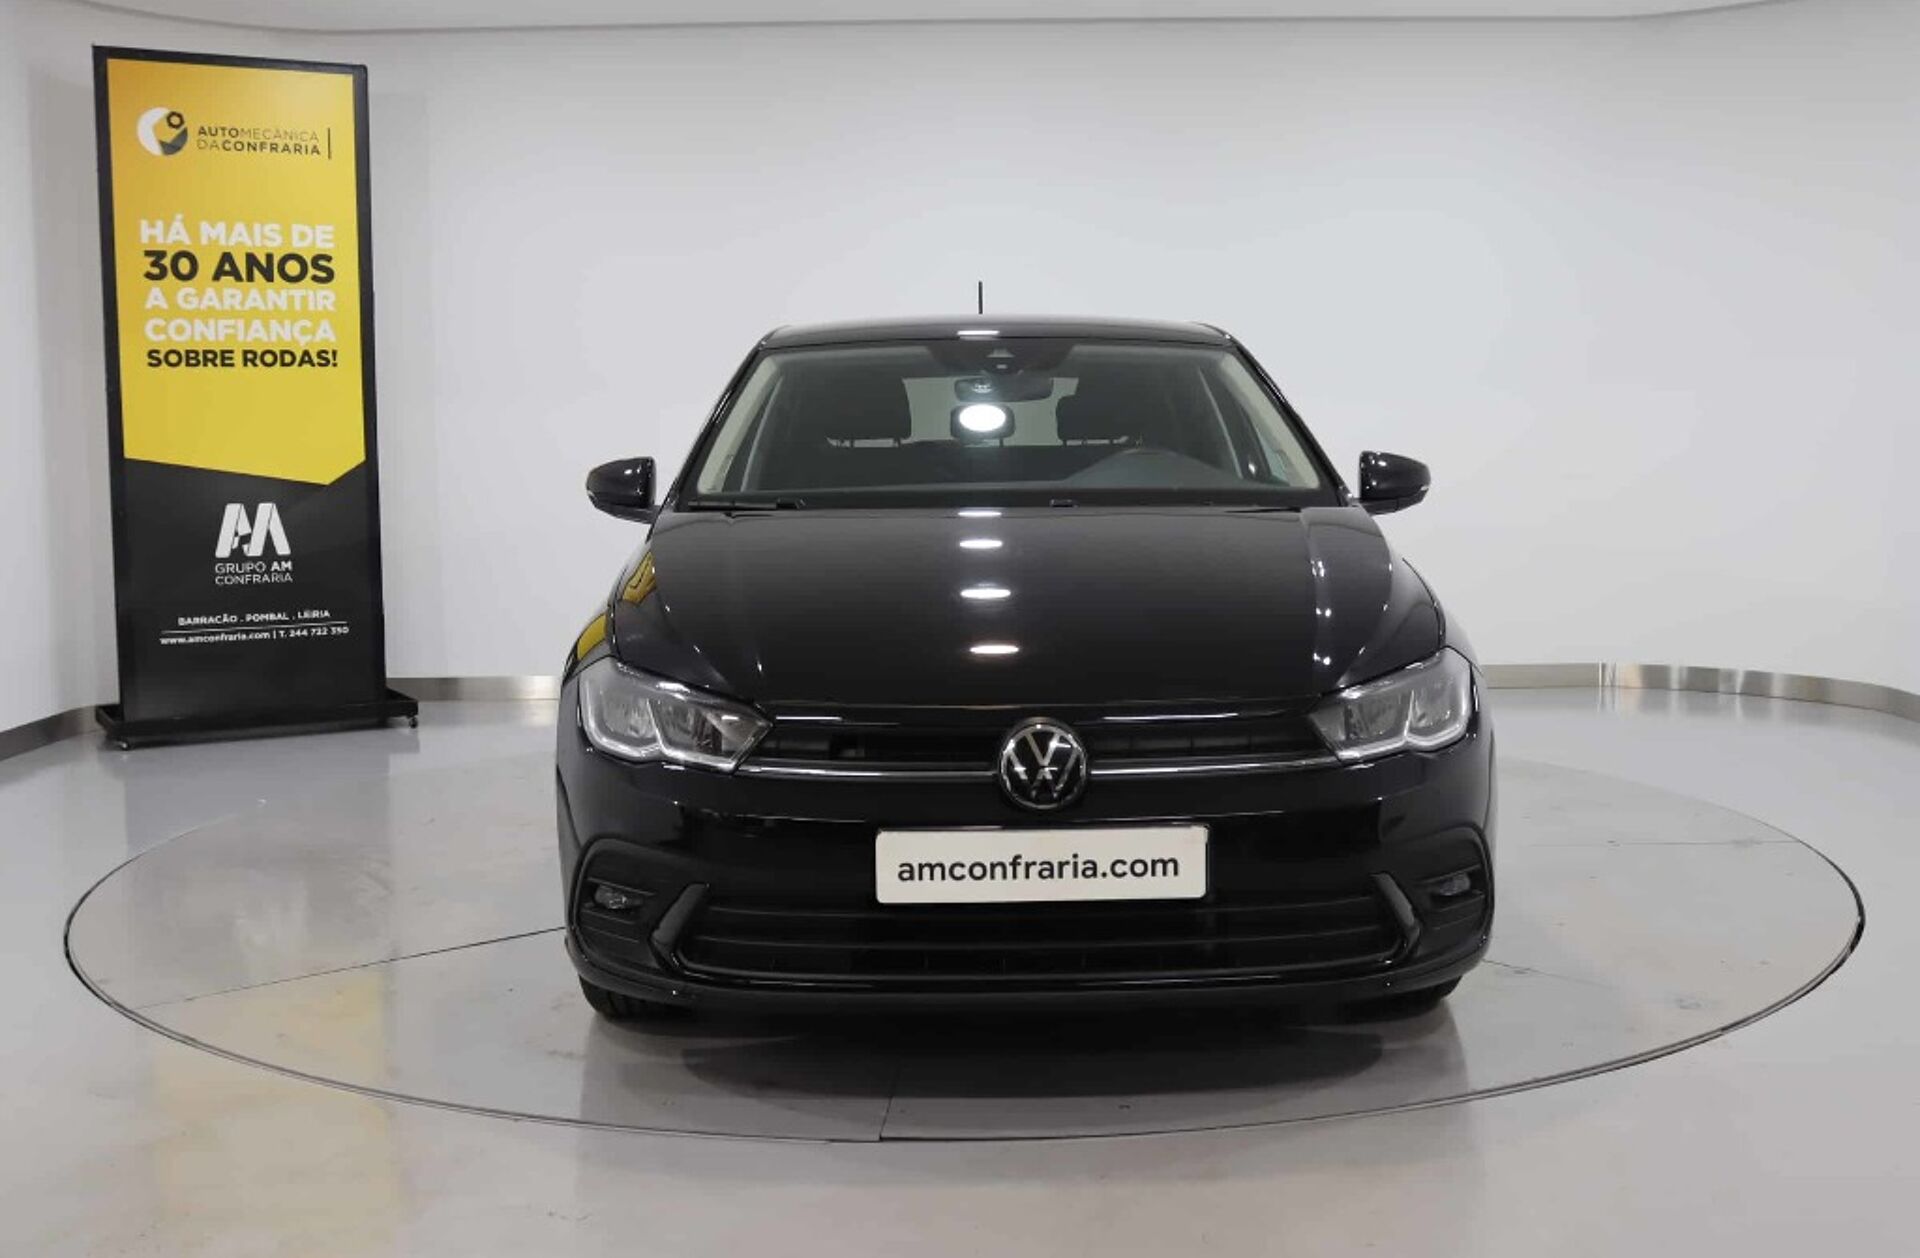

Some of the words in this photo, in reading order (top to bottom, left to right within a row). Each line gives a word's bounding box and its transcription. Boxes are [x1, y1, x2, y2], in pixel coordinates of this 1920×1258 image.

[140, 214, 191, 245] HÁ
[200, 220, 283, 248] MAIS
[291, 224, 335, 249] DE
[143, 249, 199, 282] 30
[212, 251, 335, 284] ANOS
[144, 287, 170, 311] A
[176, 287, 336, 312] GARANTIR
[144, 317, 337, 346] CONFIANÇA
[147, 349, 235, 368] SOBRE
[242, 349, 339, 368] RODAS!
[215, 562, 266, 574] GRUPO
[270, 560, 293, 573] AM
[215, 572, 293, 585] CONFRARIA
[245, 612, 290, 622] POMBAL
[297, 609, 331, 619] LEIRIA
[897, 853, 1180, 881] amconfraria.com
